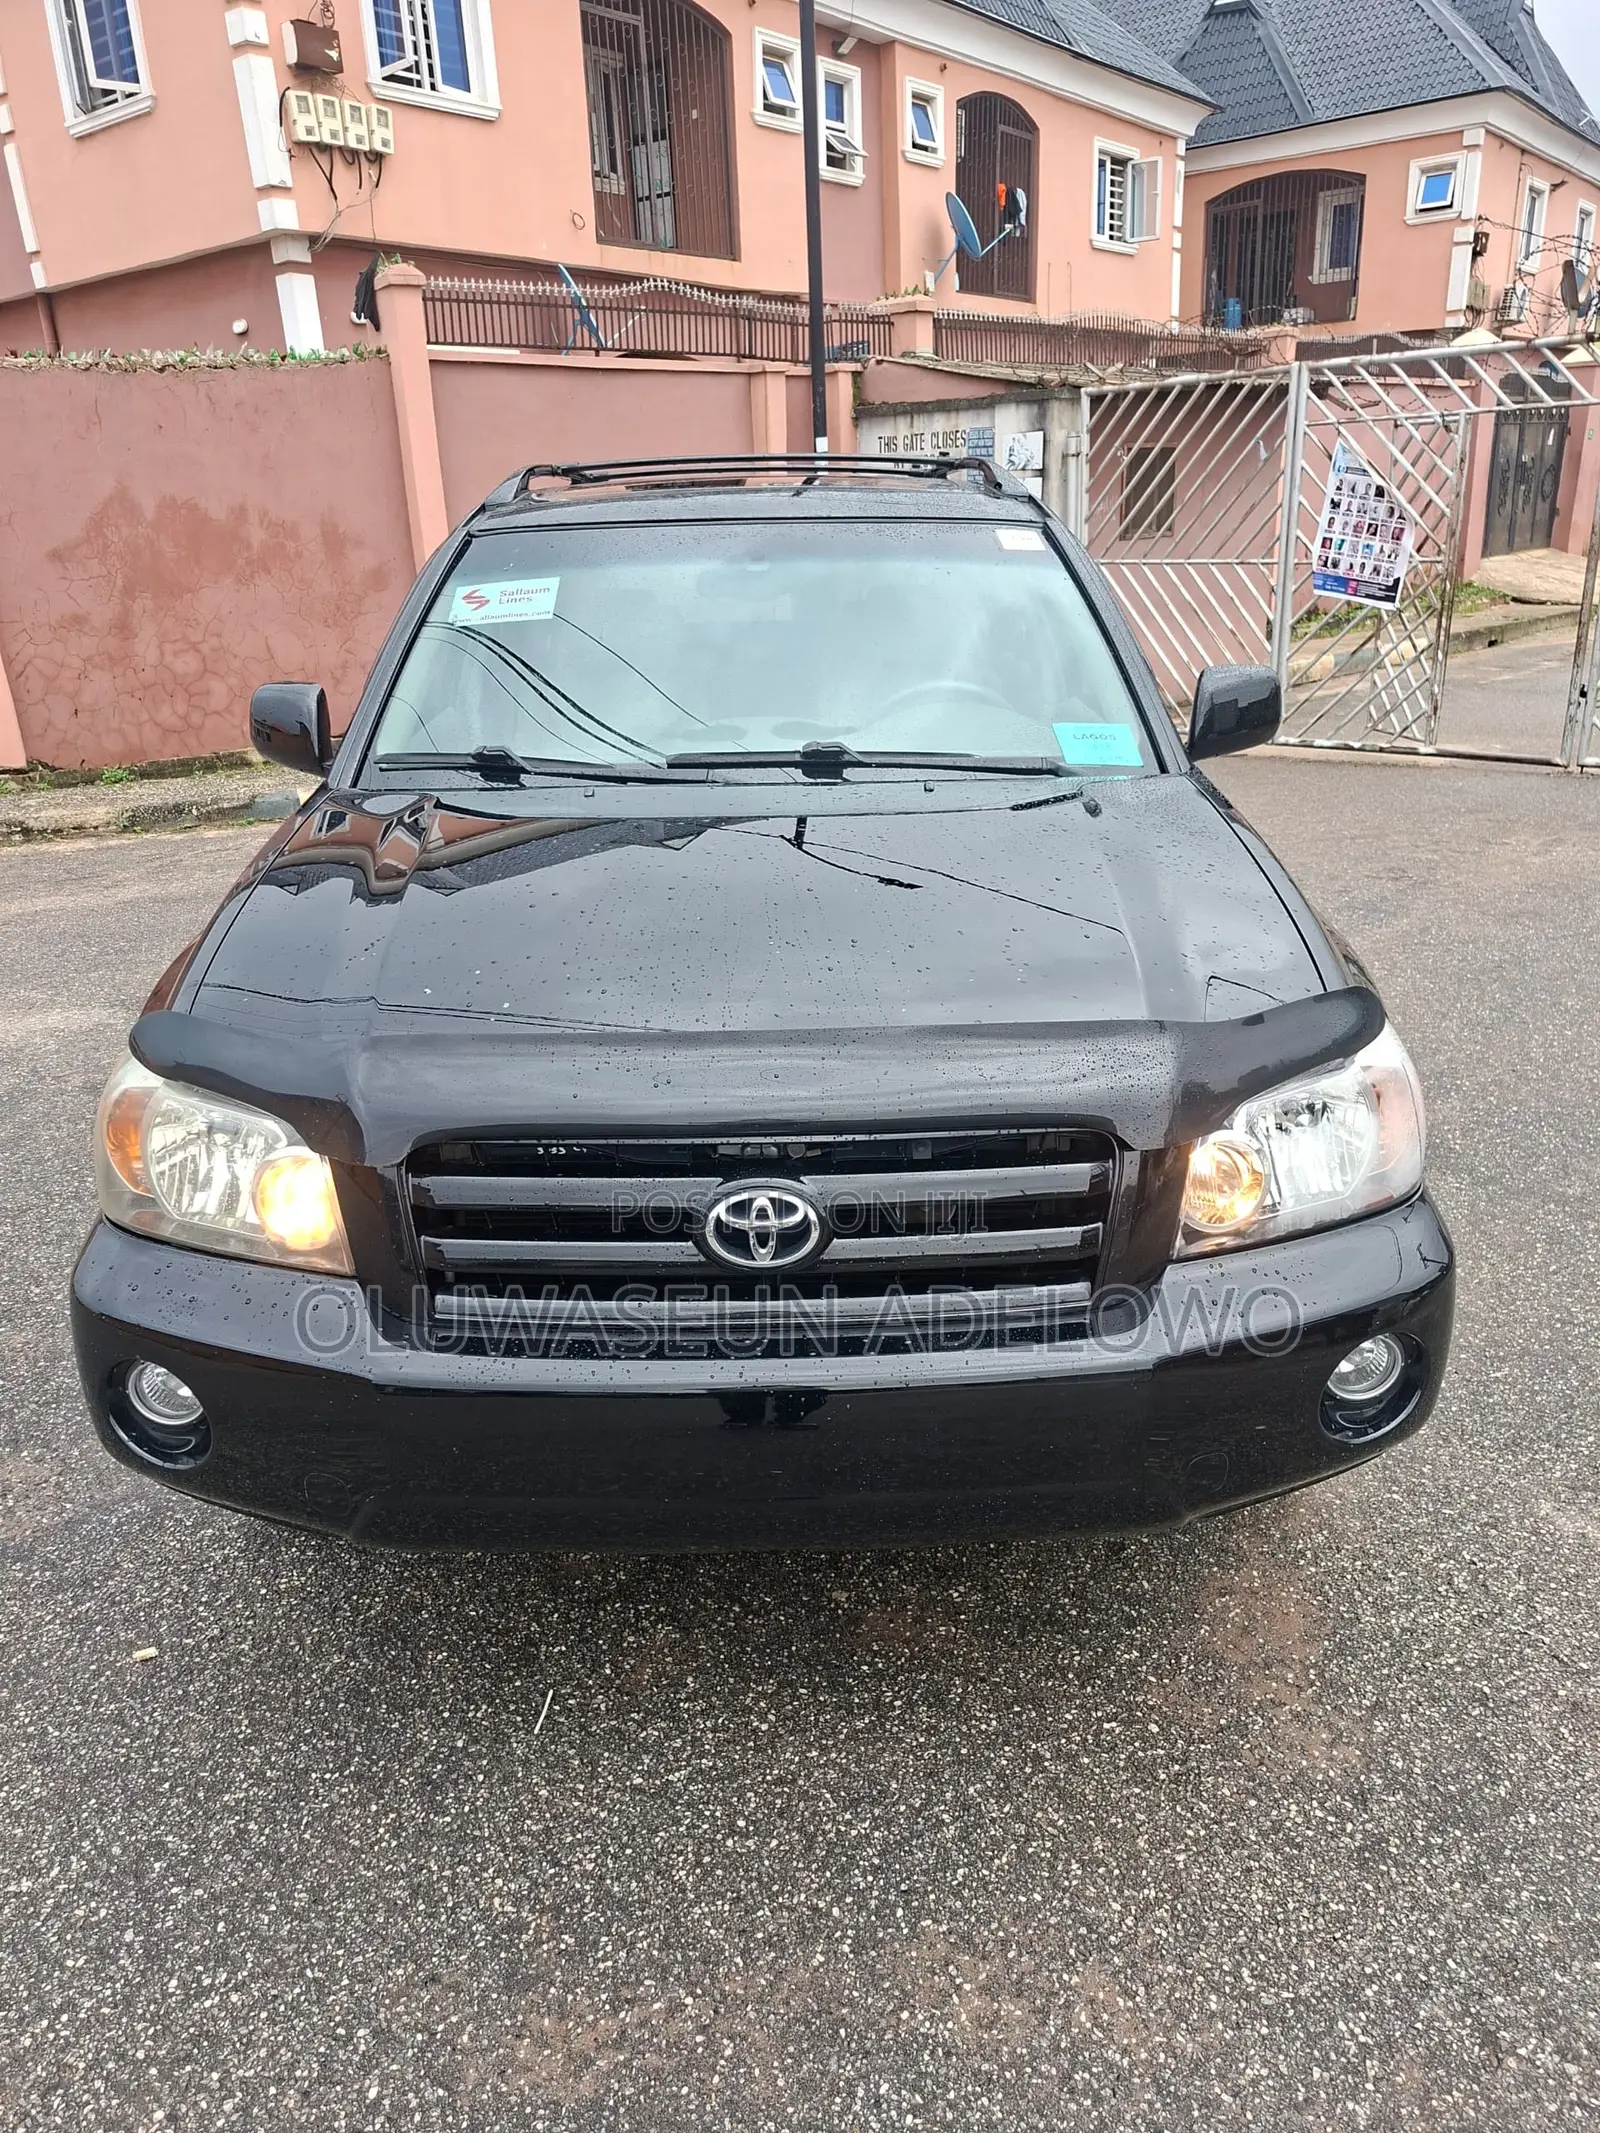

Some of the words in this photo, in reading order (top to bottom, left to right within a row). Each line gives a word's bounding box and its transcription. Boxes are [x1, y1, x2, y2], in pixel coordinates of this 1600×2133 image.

[878, 435, 898, 454] THIS
[903, 433, 925, 452] GATE
[930, 429, 967, 450] CLOSES
[500, 587, 550, 597] Sallaum
[499, 596, 533, 605] Lines
[1073, 733, 1116, 741] LAGOS
